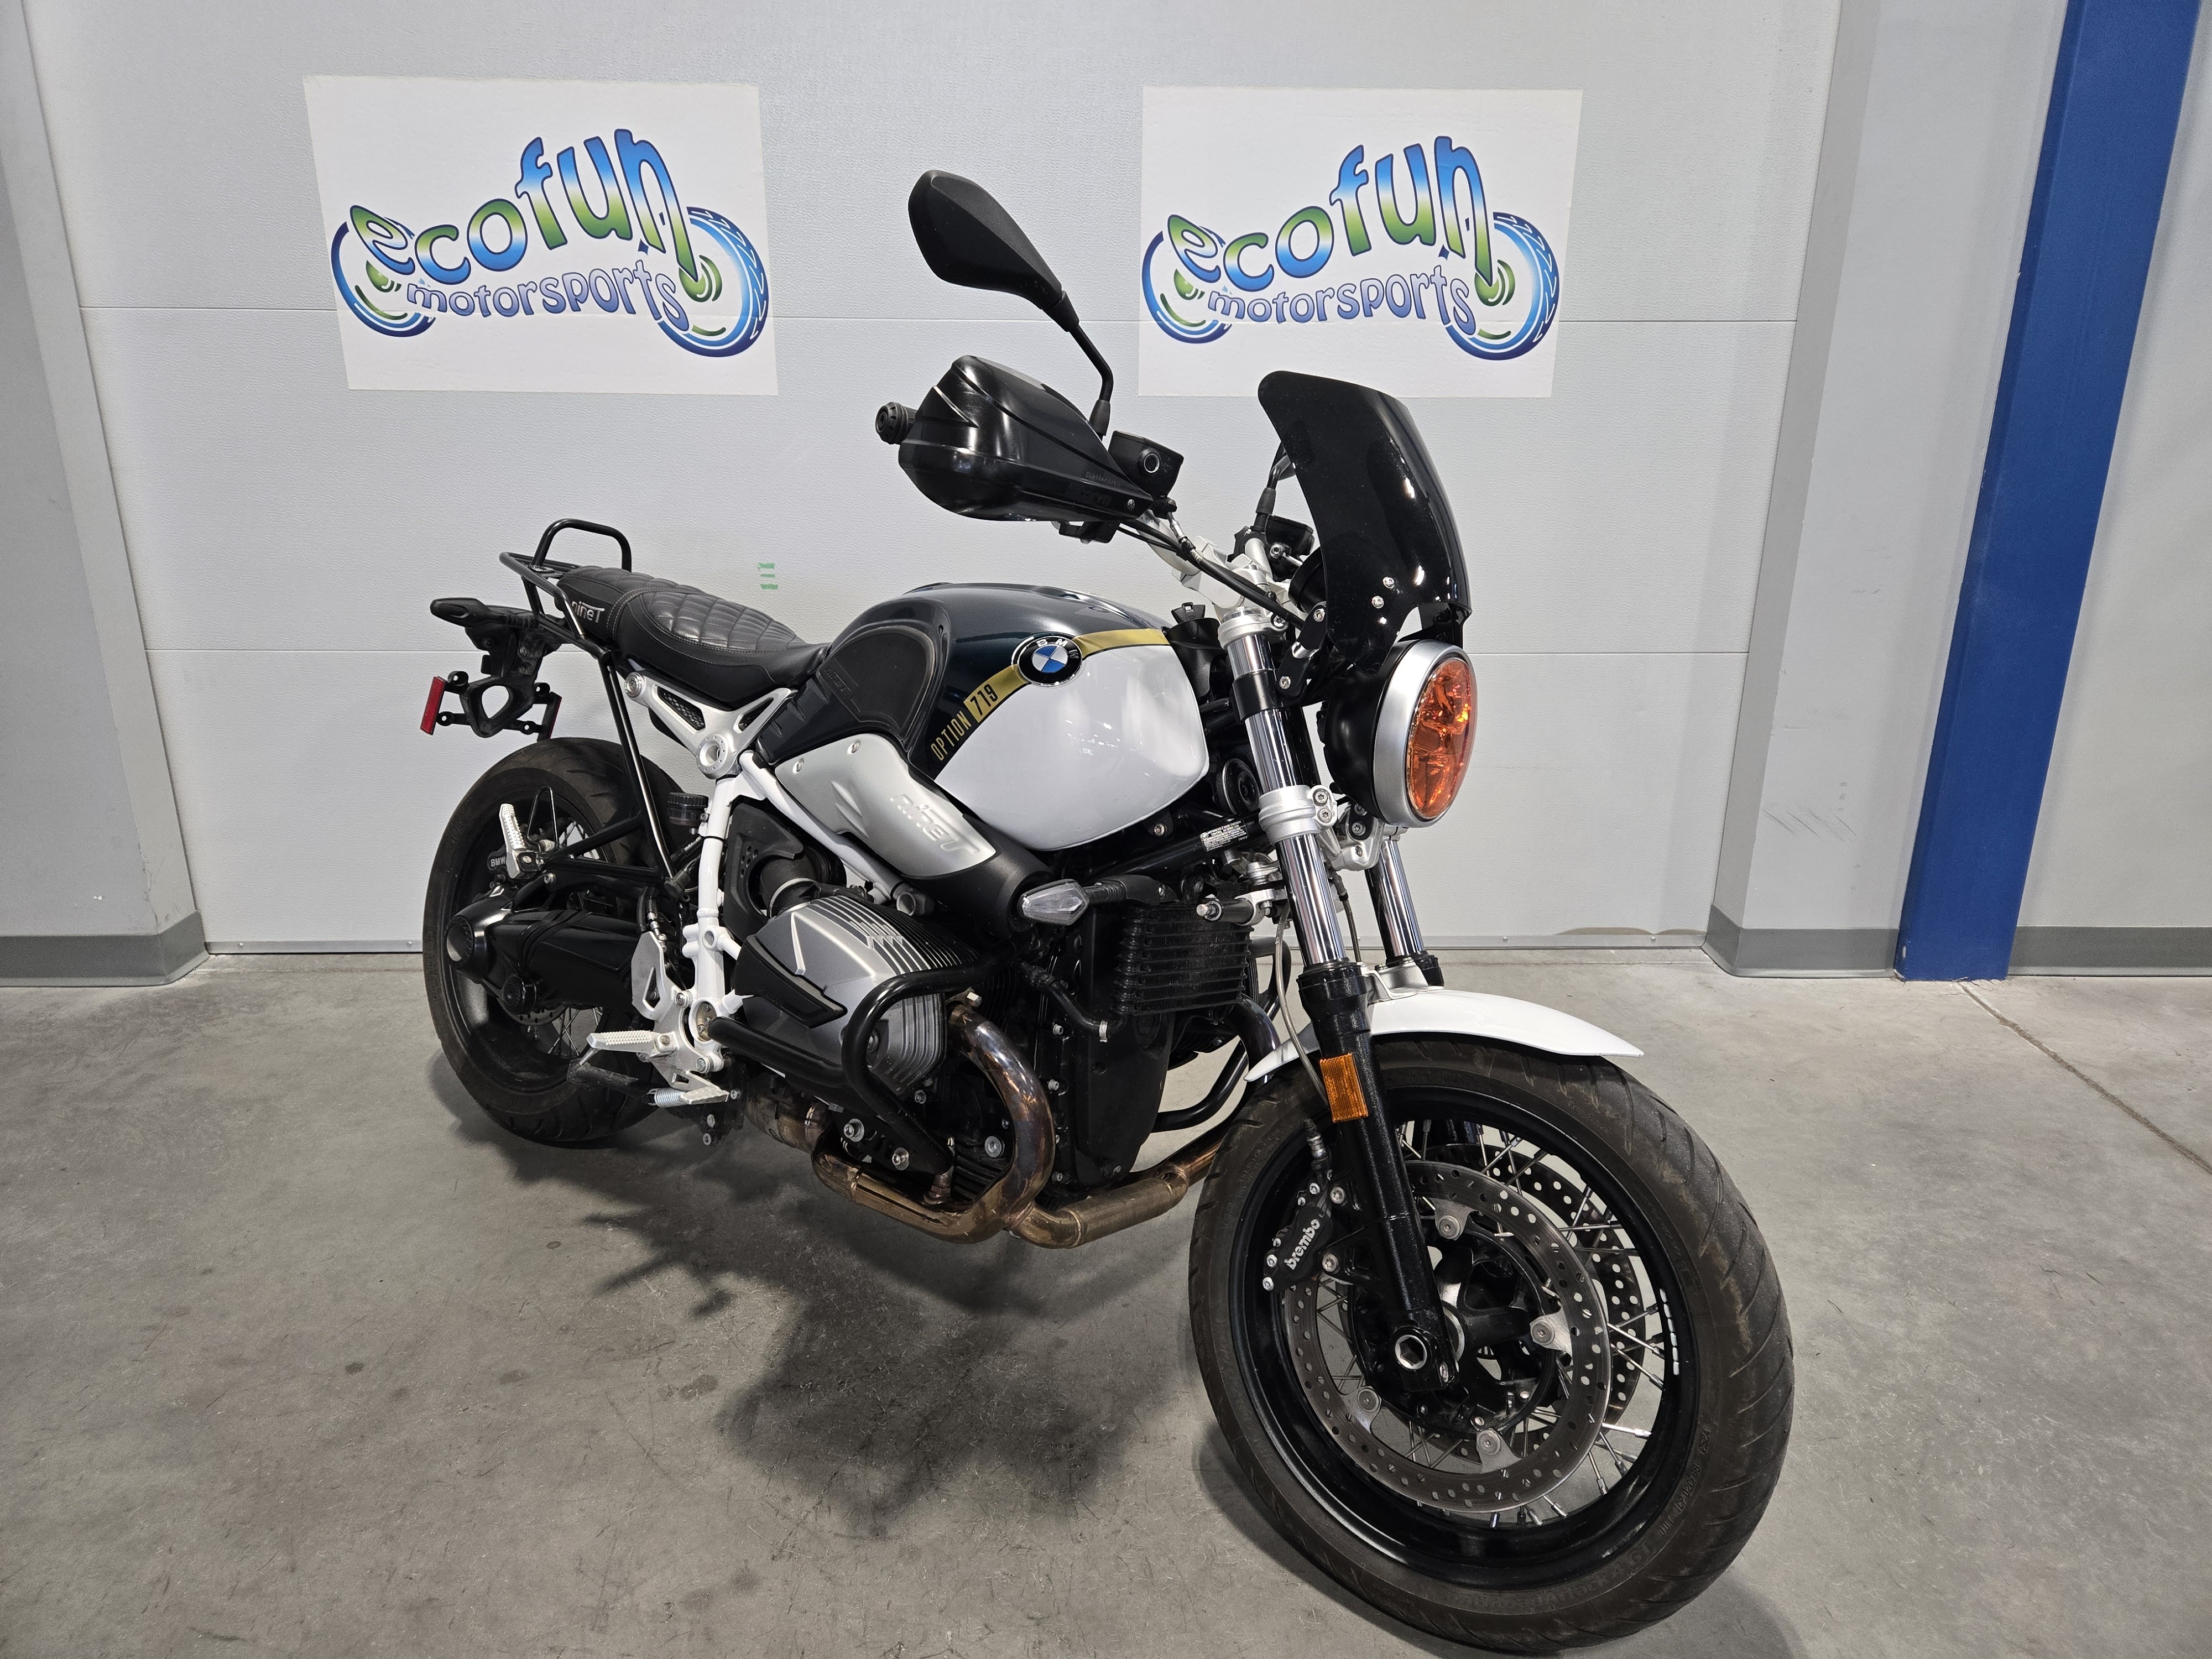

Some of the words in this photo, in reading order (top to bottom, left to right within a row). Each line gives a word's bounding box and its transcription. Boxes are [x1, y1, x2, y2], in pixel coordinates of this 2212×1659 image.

[406, 260, 689, 332] motorsports
[1208, 265, 1475, 336] motorsports
[571, 601, 605, 623] nineT
[1036, 638, 1079, 659] BMW
[930, 711, 972, 761] OPTION
[970, 684, 998, 716] 719
[890, 794, 980, 853] nineT
[491, 857, 506, 867] BMW
[1284, 1219, 1320, 1270] brembo
